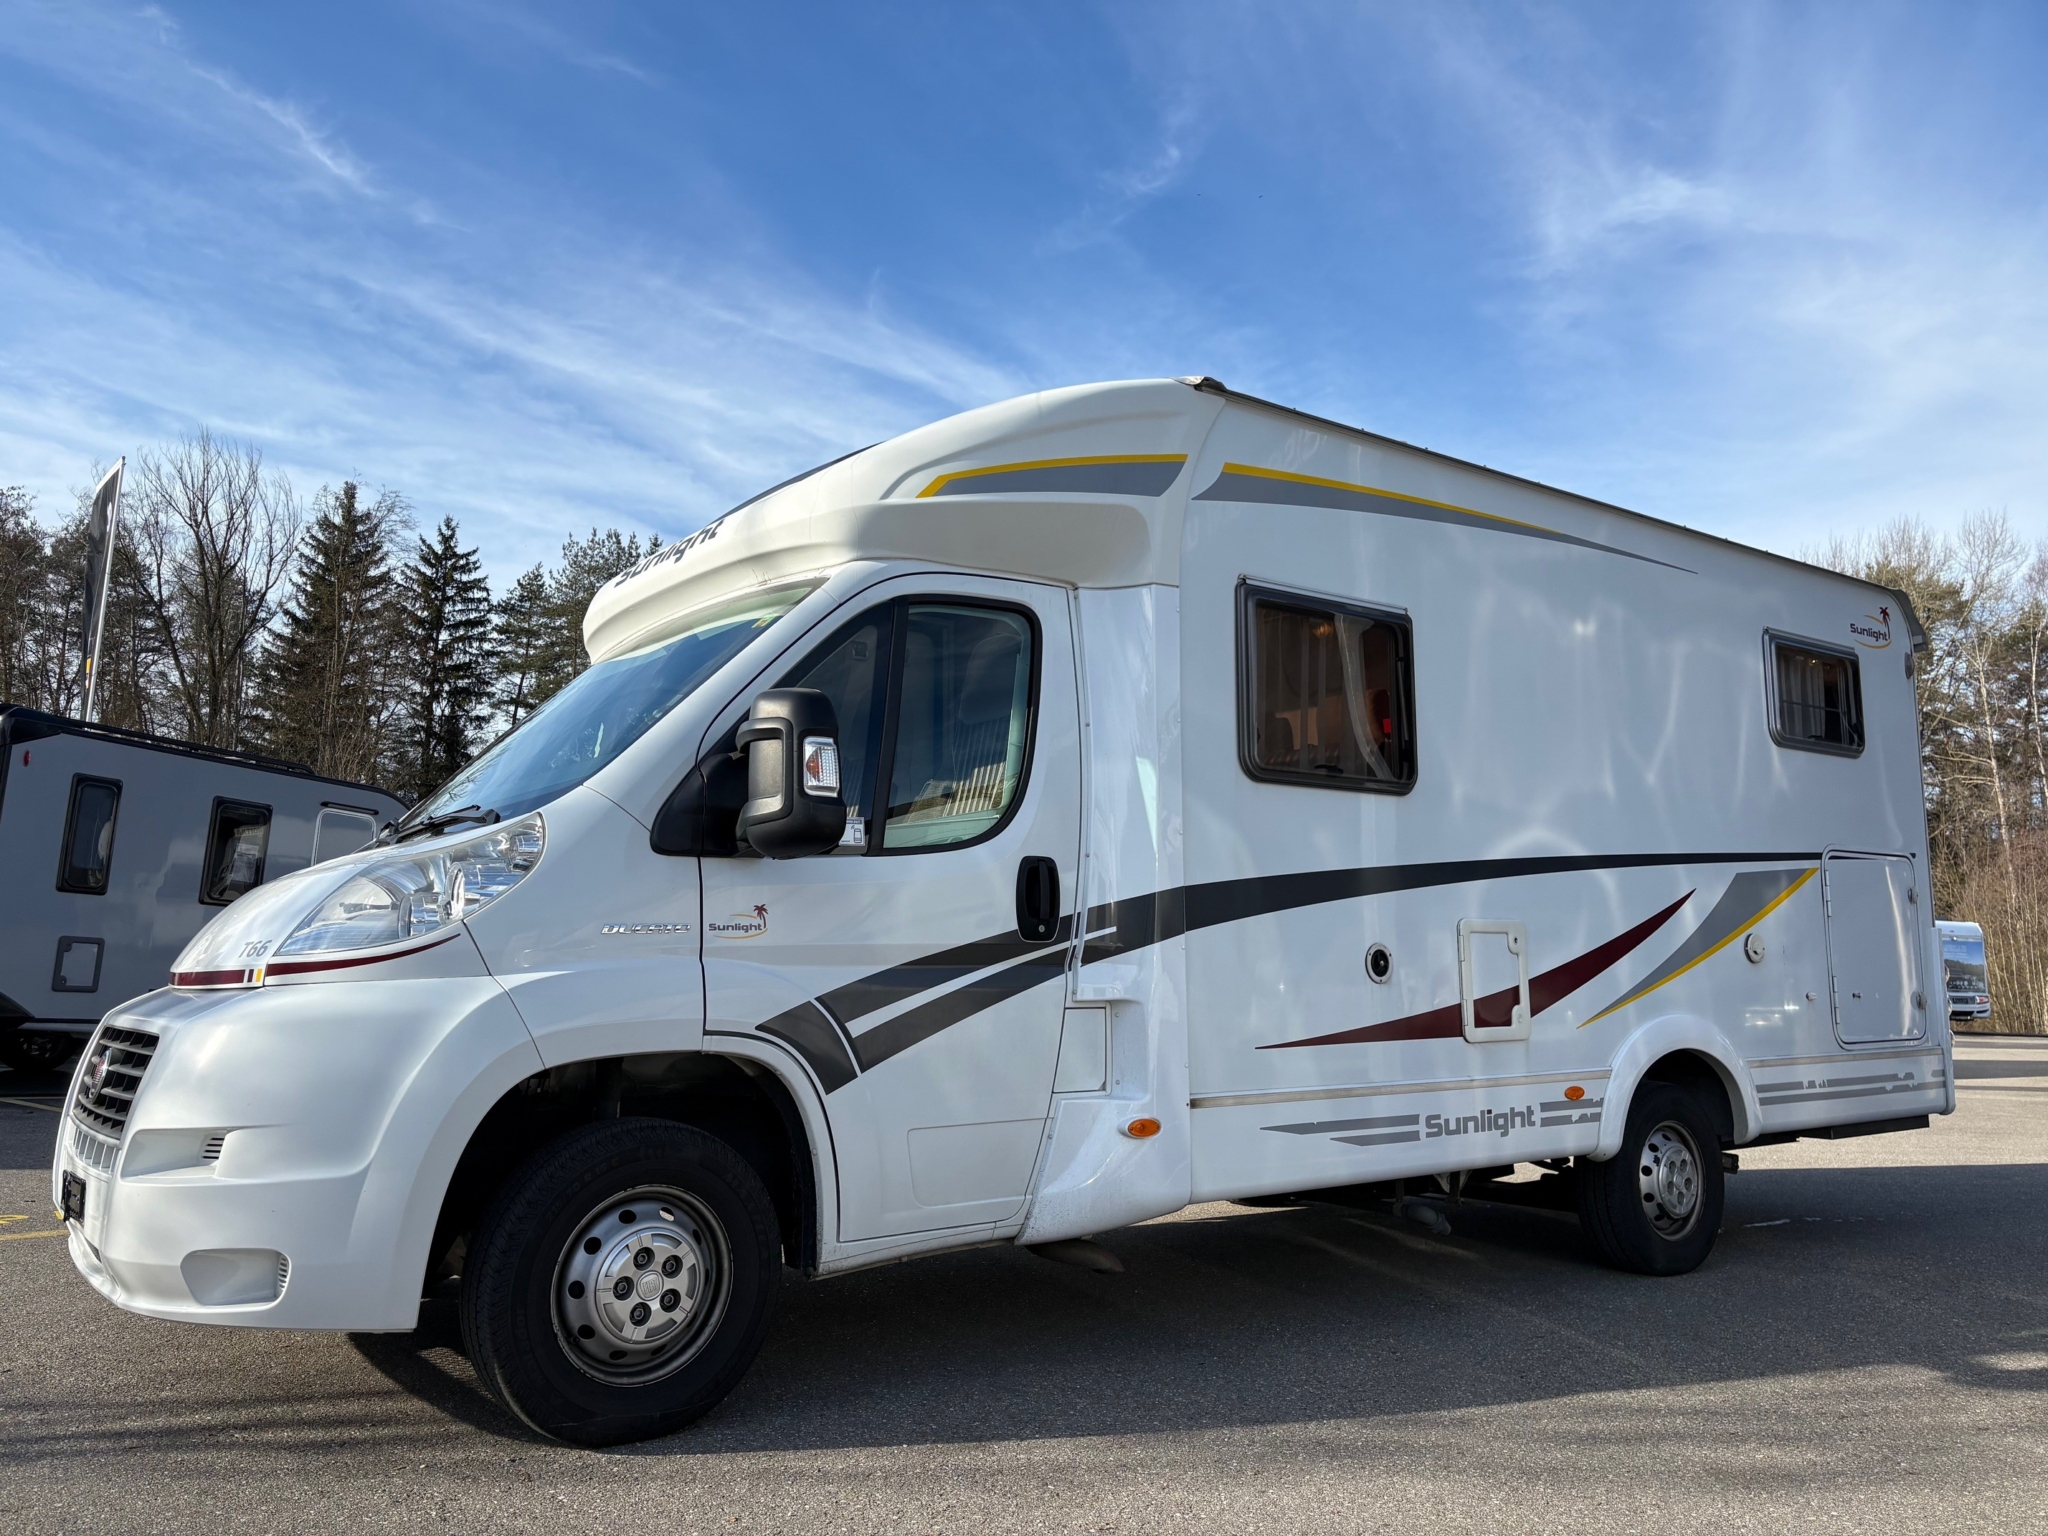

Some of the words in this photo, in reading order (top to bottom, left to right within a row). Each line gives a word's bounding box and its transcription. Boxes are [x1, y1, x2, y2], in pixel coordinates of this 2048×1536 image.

[1850, 623, 1888, 642] Sunlight
[601, 922, 691, 935] DUCATO
[708, 923, 763, 933] Sunlight
[238, 939, 273, 958] T66
[1425, 1105, 1536, 1138] Sunlight
[642, 1277, 658, 1295] FIAT
